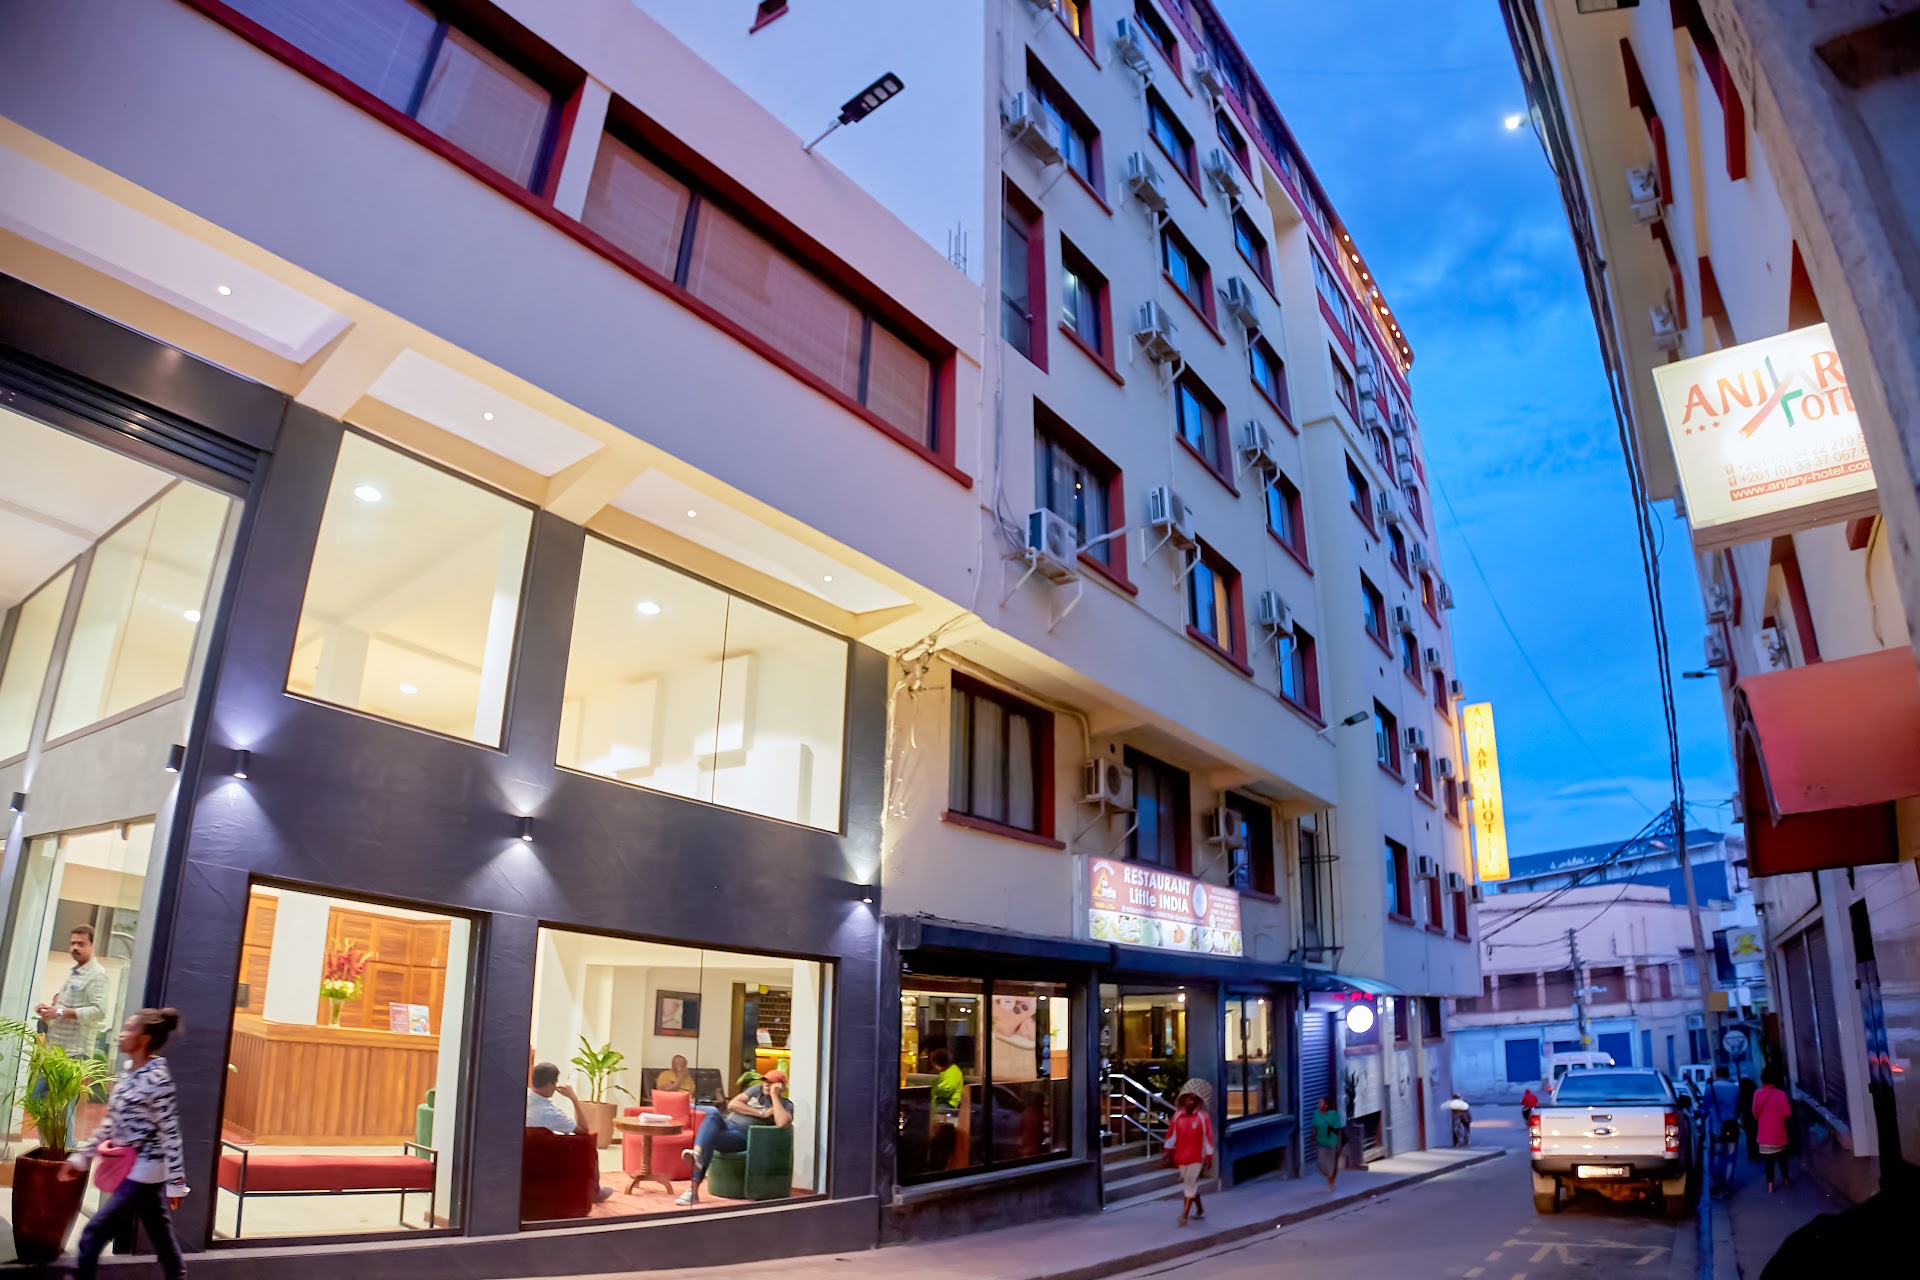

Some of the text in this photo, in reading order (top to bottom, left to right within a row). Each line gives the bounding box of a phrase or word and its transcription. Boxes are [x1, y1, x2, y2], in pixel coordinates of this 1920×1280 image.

[1682, 351, 1847, 437] ANJAR
[1815, 453, 1829, 467] 37
[1834, 448, 1856, 463] 067
[1123, 867, 1191, 896] RESTAURANT
[1130, 888, 1156, 908] Little
[1159, 894, 1190, 914] INDIA
